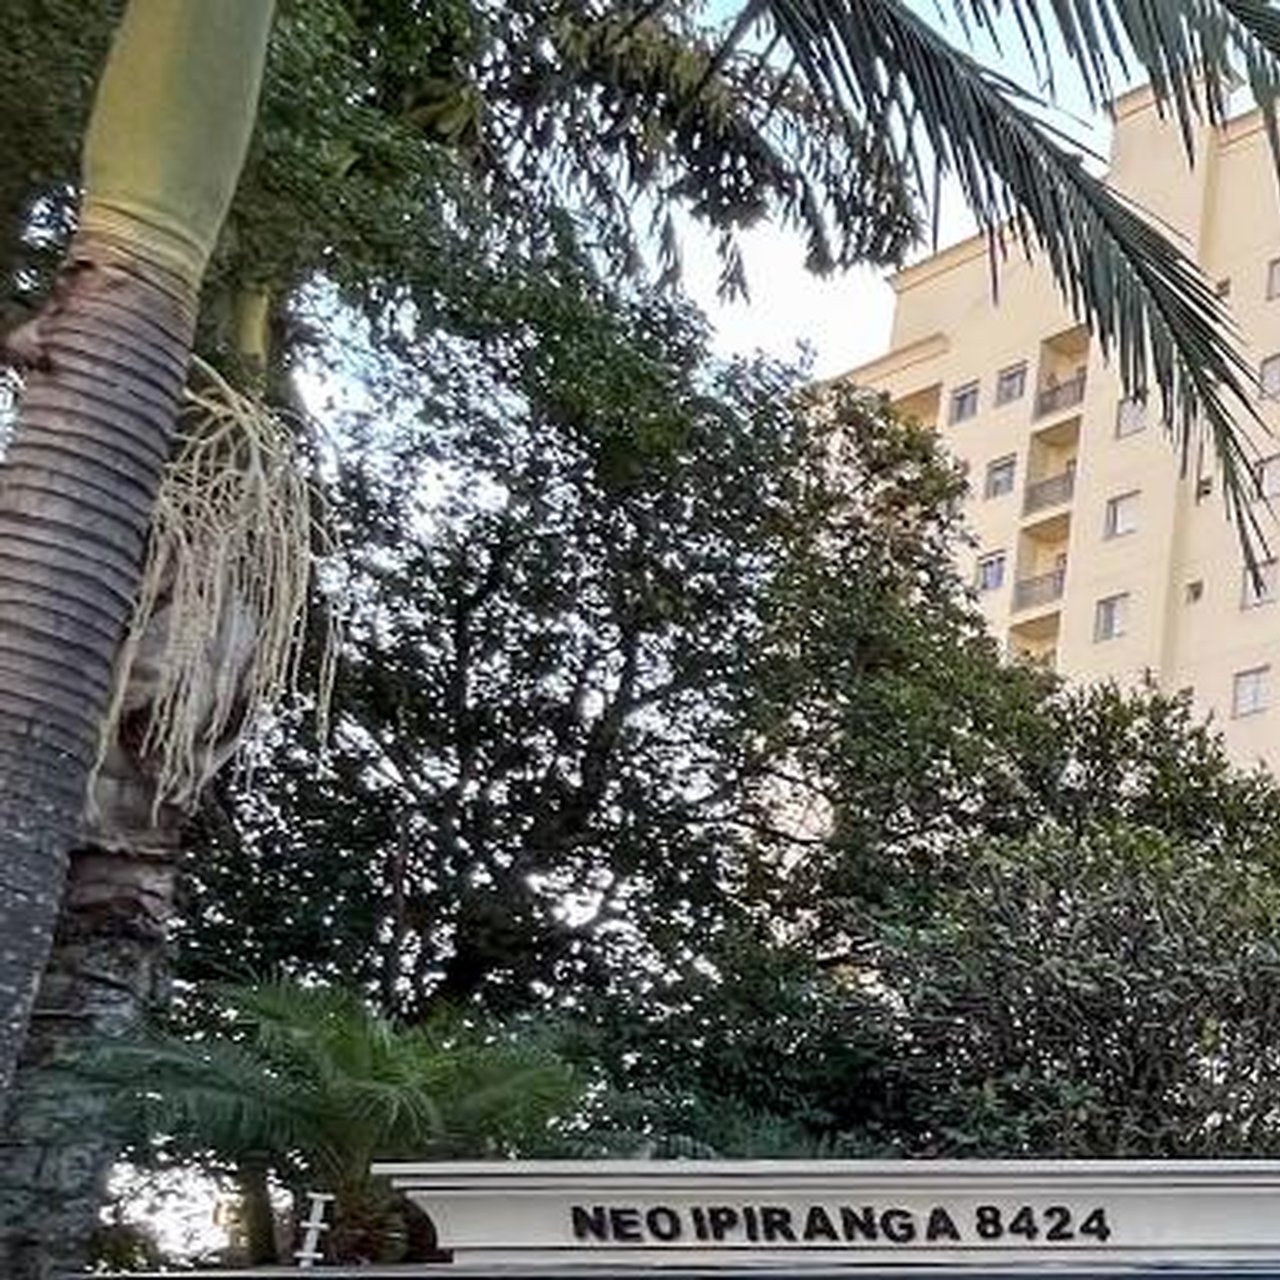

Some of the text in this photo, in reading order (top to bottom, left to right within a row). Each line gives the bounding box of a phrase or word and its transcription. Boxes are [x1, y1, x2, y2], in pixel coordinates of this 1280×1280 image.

[571, 1205, 1112, 1243] NEO IPIRANGA 8424
